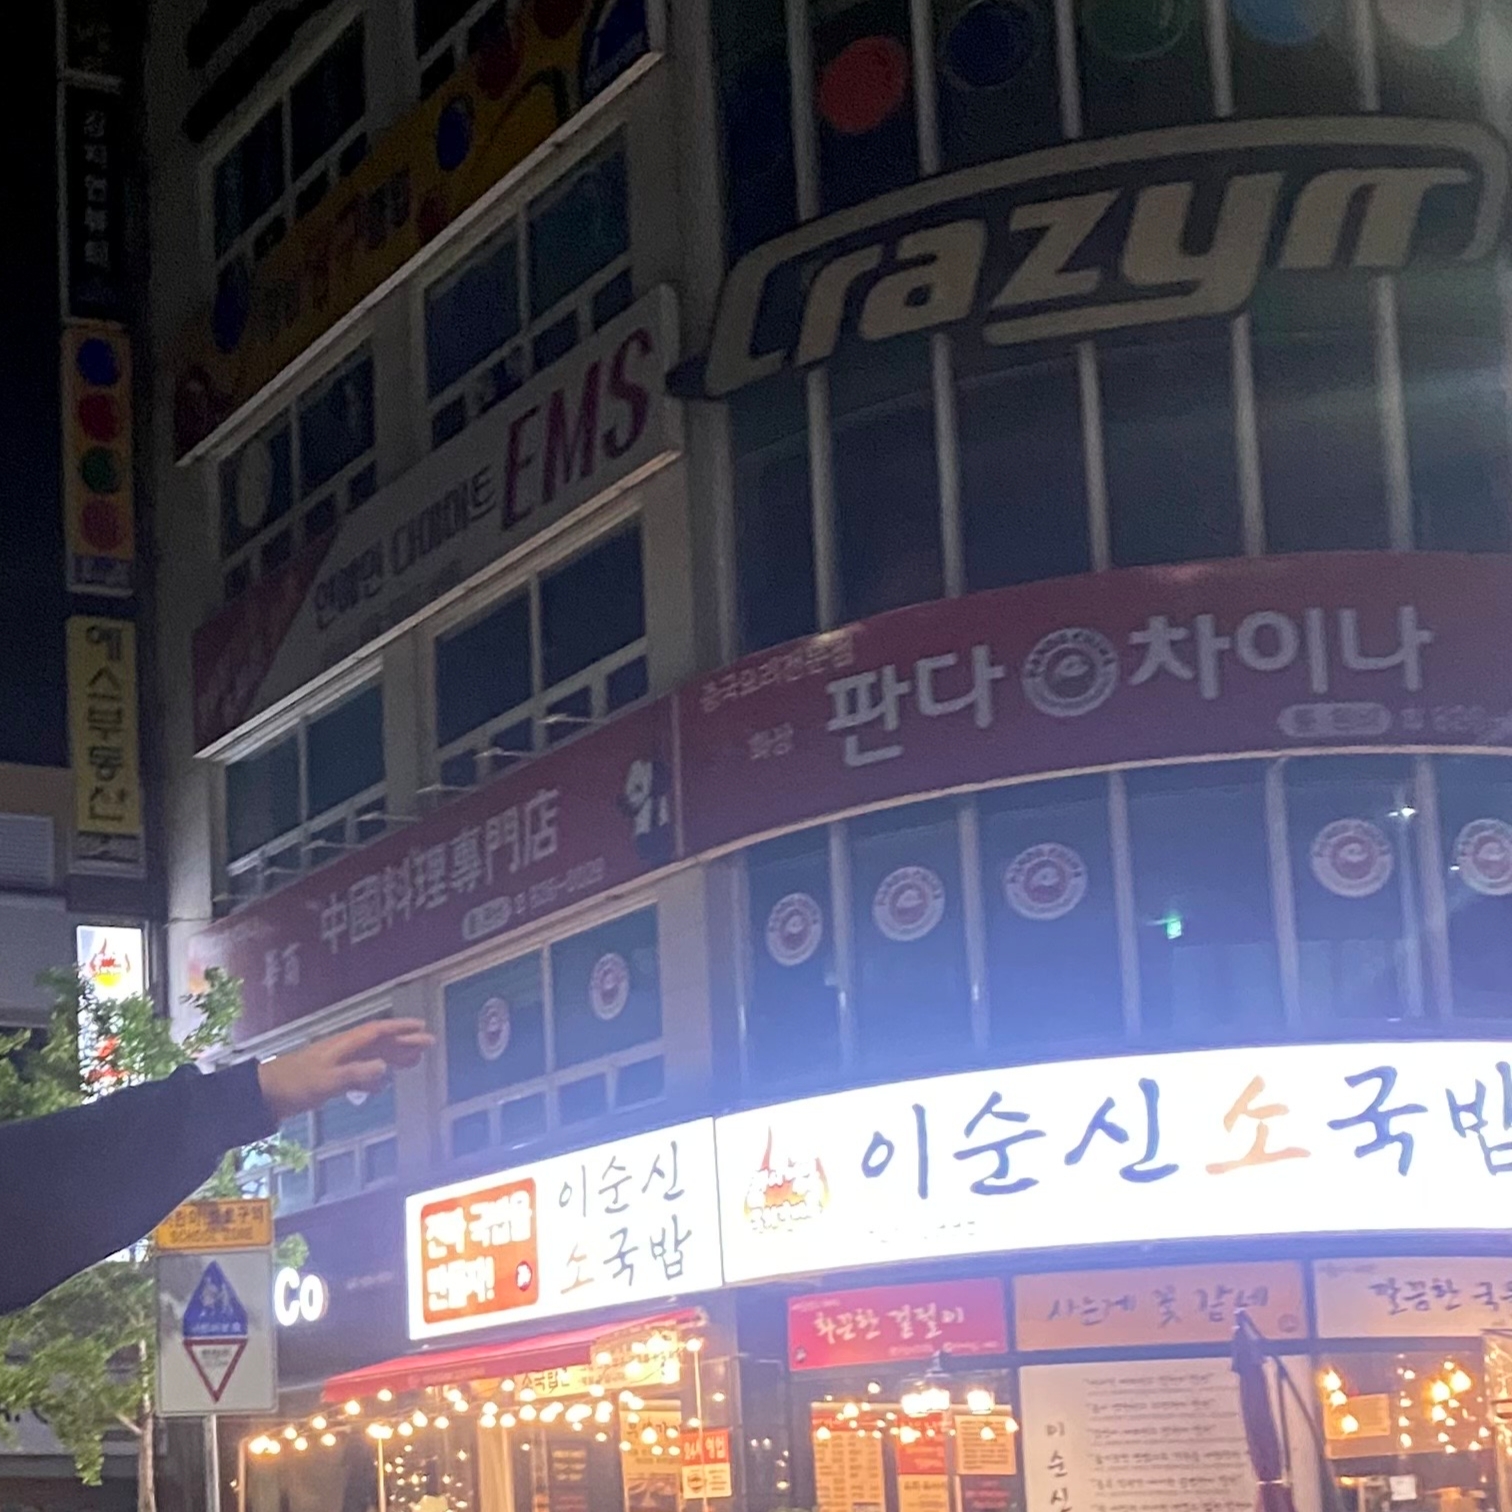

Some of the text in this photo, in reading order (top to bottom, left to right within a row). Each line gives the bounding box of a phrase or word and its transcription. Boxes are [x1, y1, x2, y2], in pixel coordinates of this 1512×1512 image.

[501, 328, 655, 531] EMS
[85, 624, 126, 822] 에스부동산
[825, 644, 1007, 767] 판다
[1127, 604, 1434, 701] 차이나
[320, 788, 560, 954] 中國料理專門店
[557, 1140, 686, 1219] 이순신
[560, 1213, 693, 1296] 소국밥
